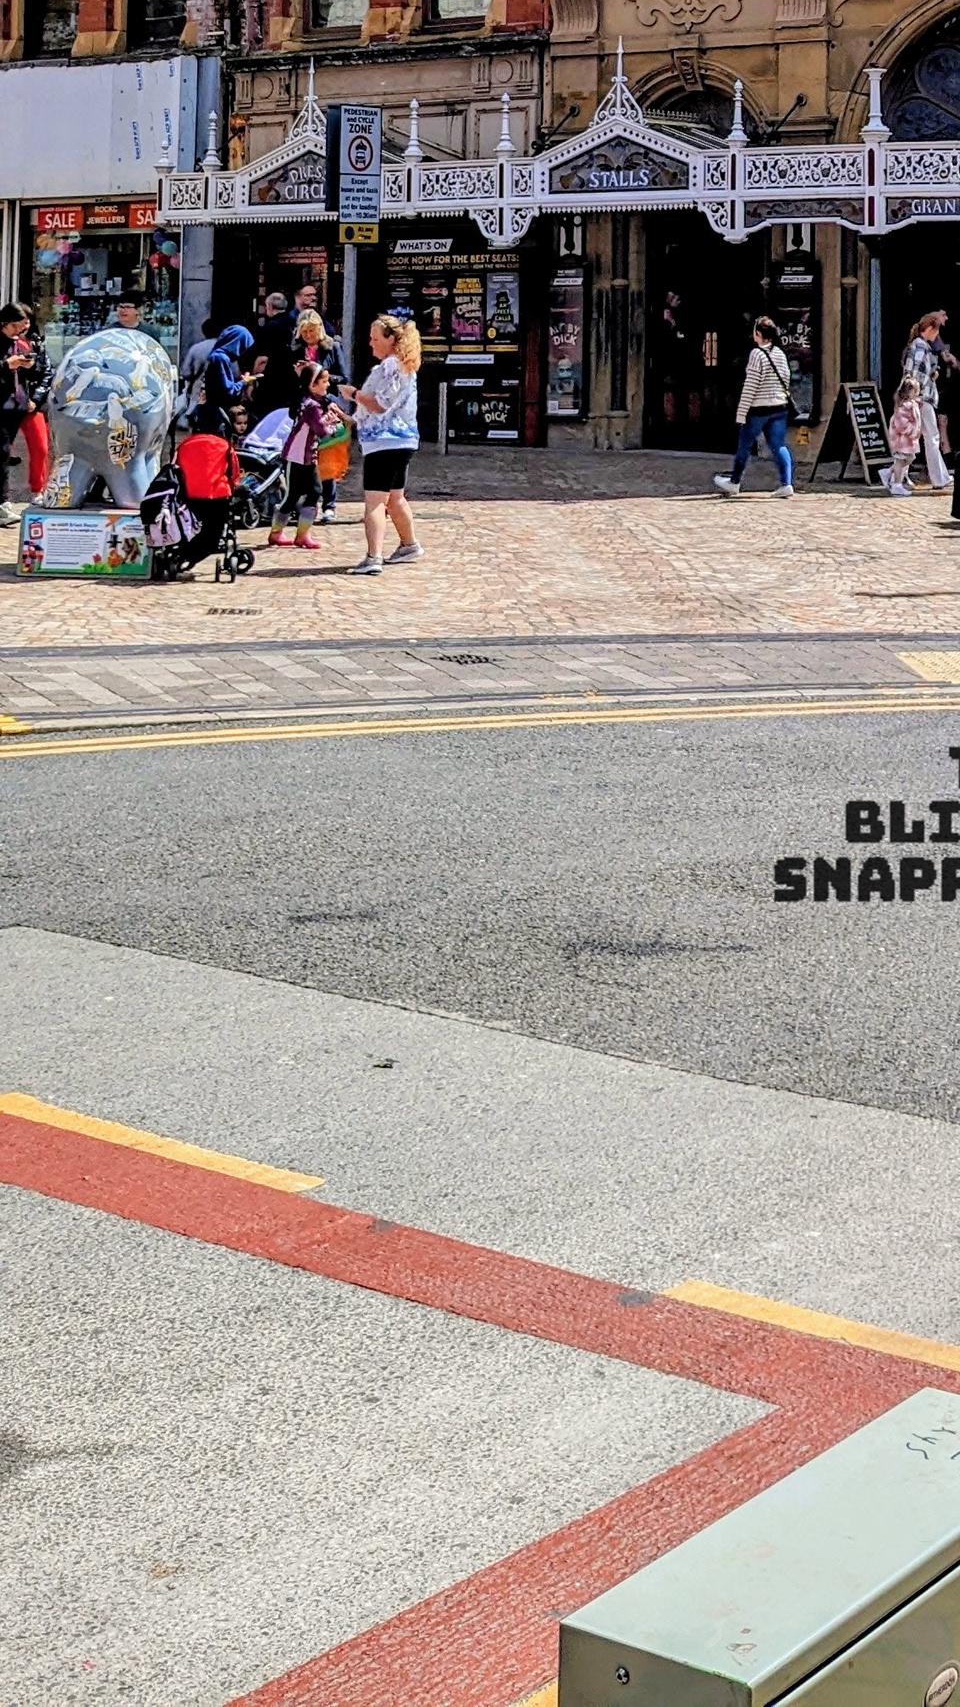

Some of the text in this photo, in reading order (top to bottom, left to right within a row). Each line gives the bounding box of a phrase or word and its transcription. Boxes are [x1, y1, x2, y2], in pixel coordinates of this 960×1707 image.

[344, 108, 378, 117] PEDESTRIAN
[349, 123, 373, 134] ZONE
[290, 165, 326, 182] DRES
[589, 169, 650, 188] STALLS
[351, 178, 369, 186] Except
[285, 183, 326, 200] CIRCL
[45, 213, 76, 229] SALE
[86, 216, 126, 224] JEWELLERS
[137, 210, 157, 225] SA
[400, 242, 448, 250] WHAT'S ON
[387, 256, 409, 265] BOOK
[412, 256, 432, 264] NOW
[434, 256, 451, 264] FOR
[452, 255, 468, 264] THE
[470, 255, 490, 263] BEST
[553, 334, 578, 345] DICK
[481, 400, 511, 413] MOBY
[484, 412, 508, 423] DICK
